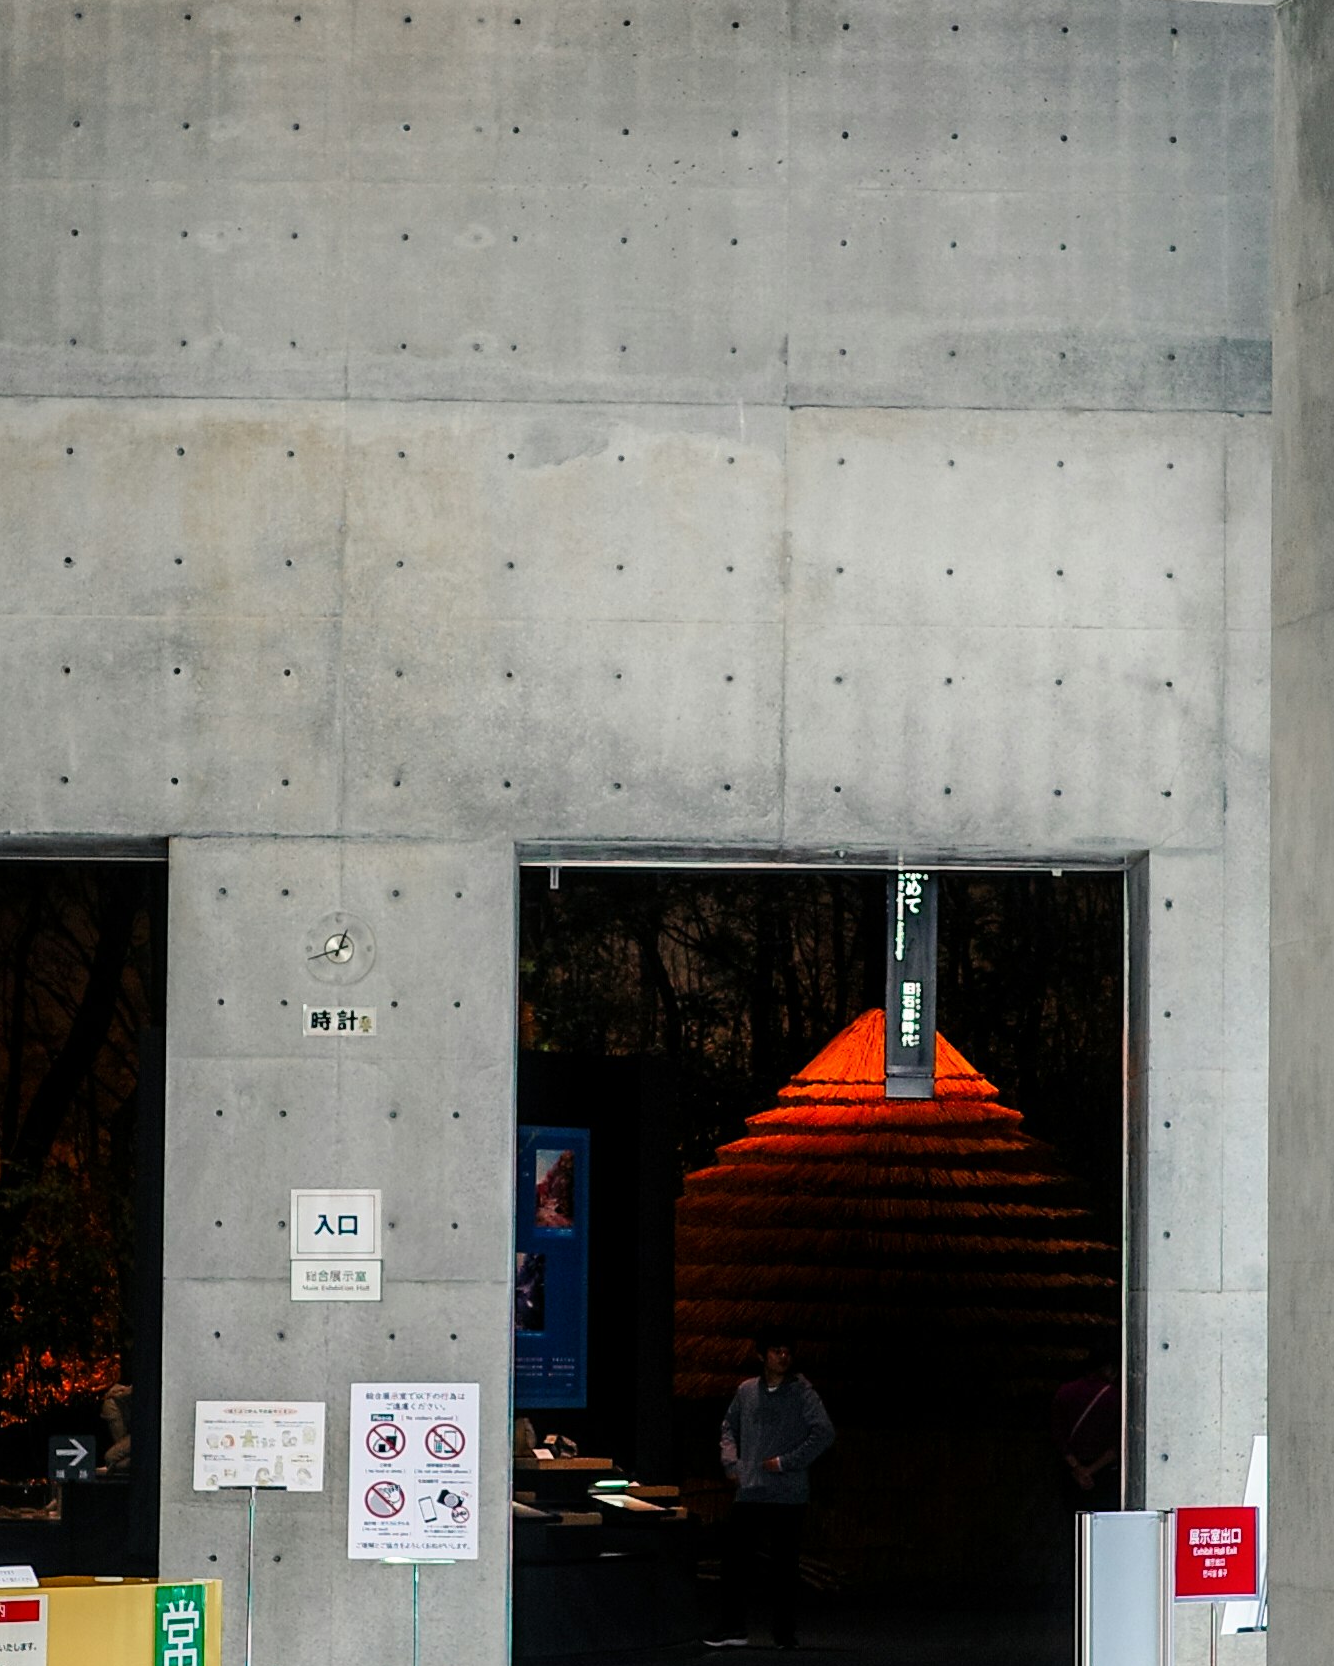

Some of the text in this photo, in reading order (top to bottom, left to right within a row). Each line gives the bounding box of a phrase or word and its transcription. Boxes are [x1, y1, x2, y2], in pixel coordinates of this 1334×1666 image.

[905, 873, 922, 914] めて
[310, 1009, 358, 1031] 時計
[314, 1214, 359, 1236] 入口
[305, 1269, 367, 1283] 総合展示室
[1189, 1528, 1242, 1545] 展示室出口
